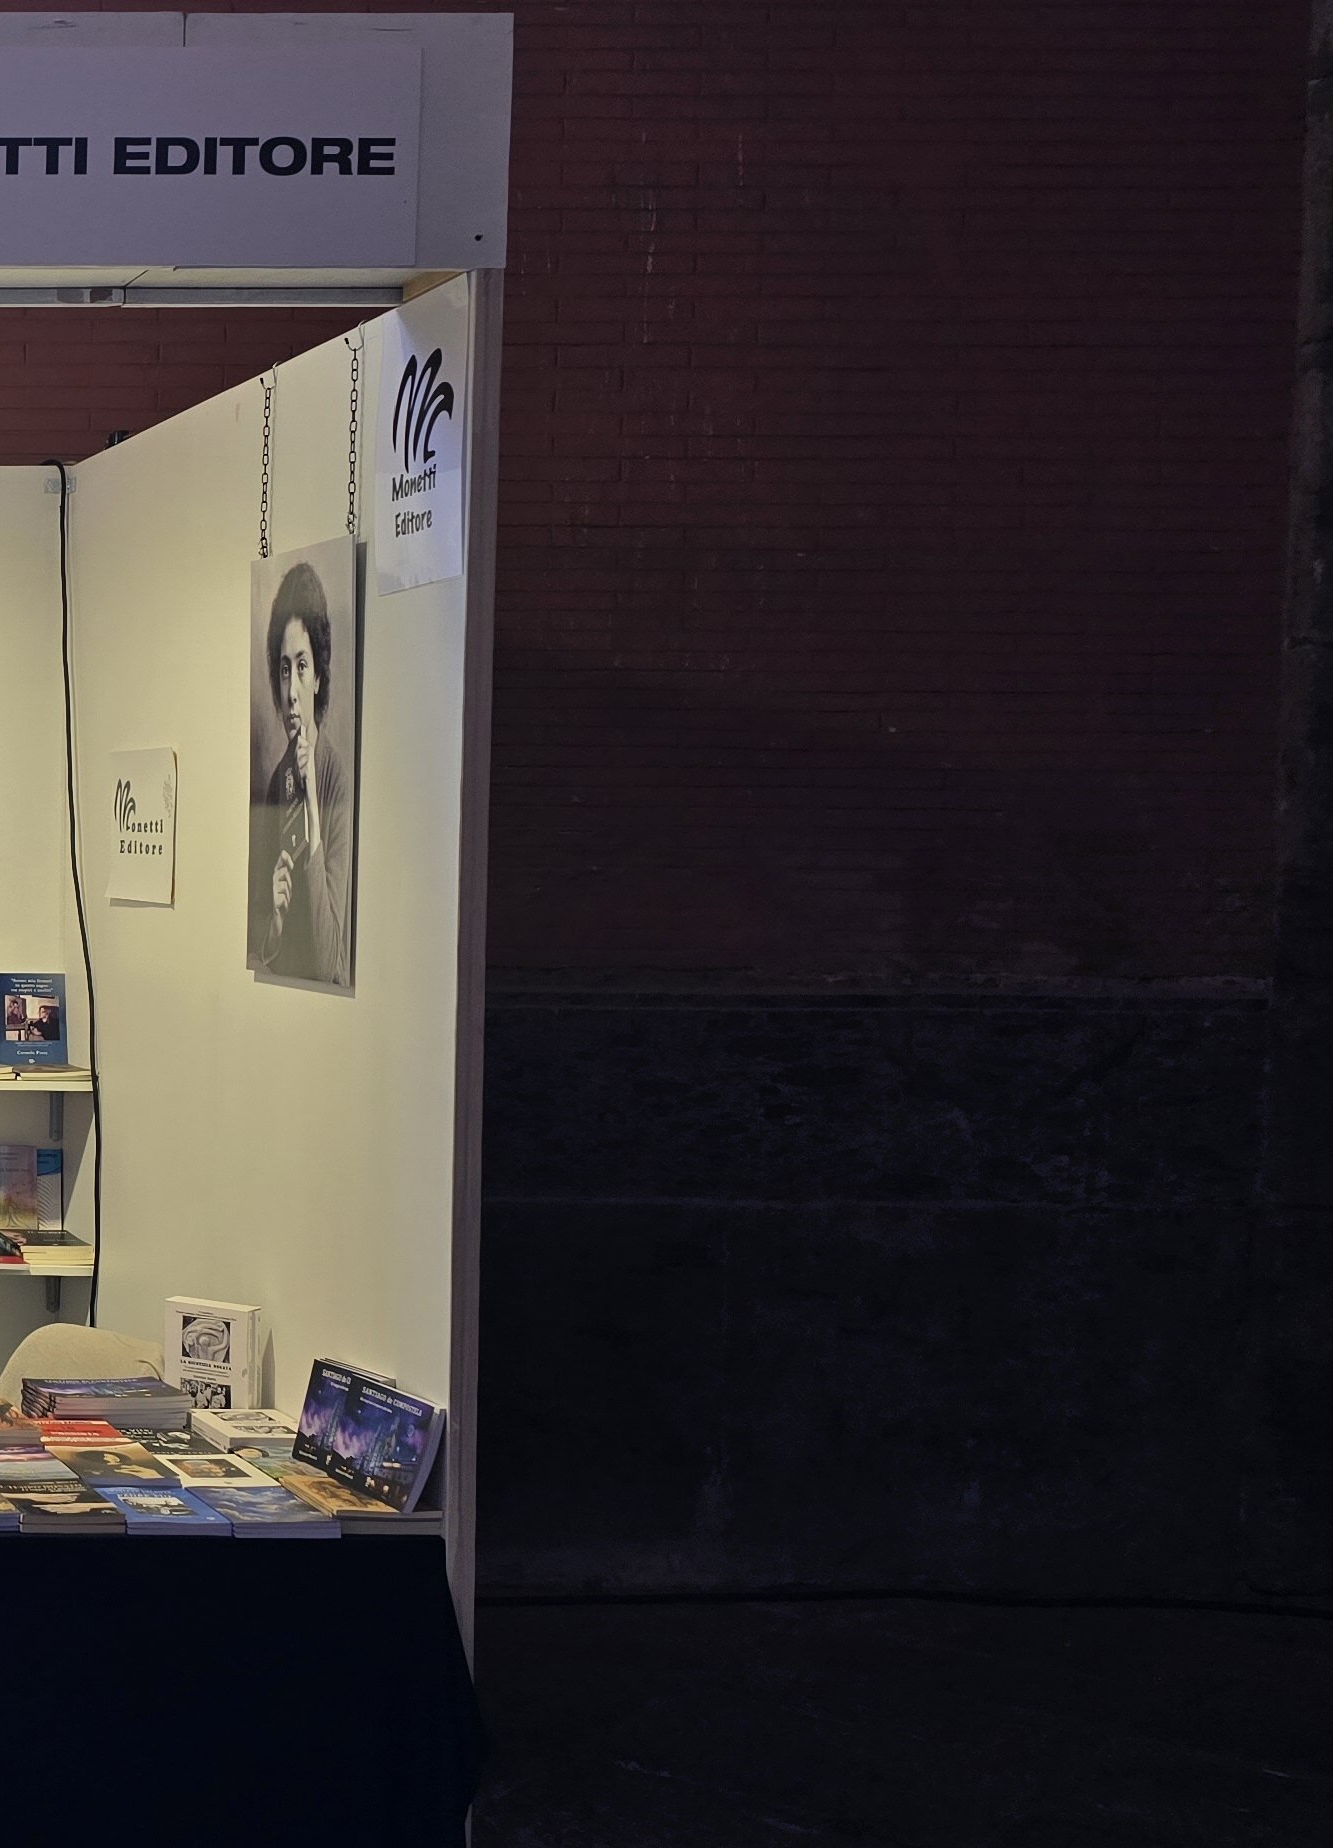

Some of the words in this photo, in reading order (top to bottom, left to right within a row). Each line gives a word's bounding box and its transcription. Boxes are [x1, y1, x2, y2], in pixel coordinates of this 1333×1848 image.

[113, 137, 396, 175] EDITORE
[391, 464, 437, 501] Monetti
[394, 509, 433, 538] Editore
[119, 839, 163, 855] Editore
